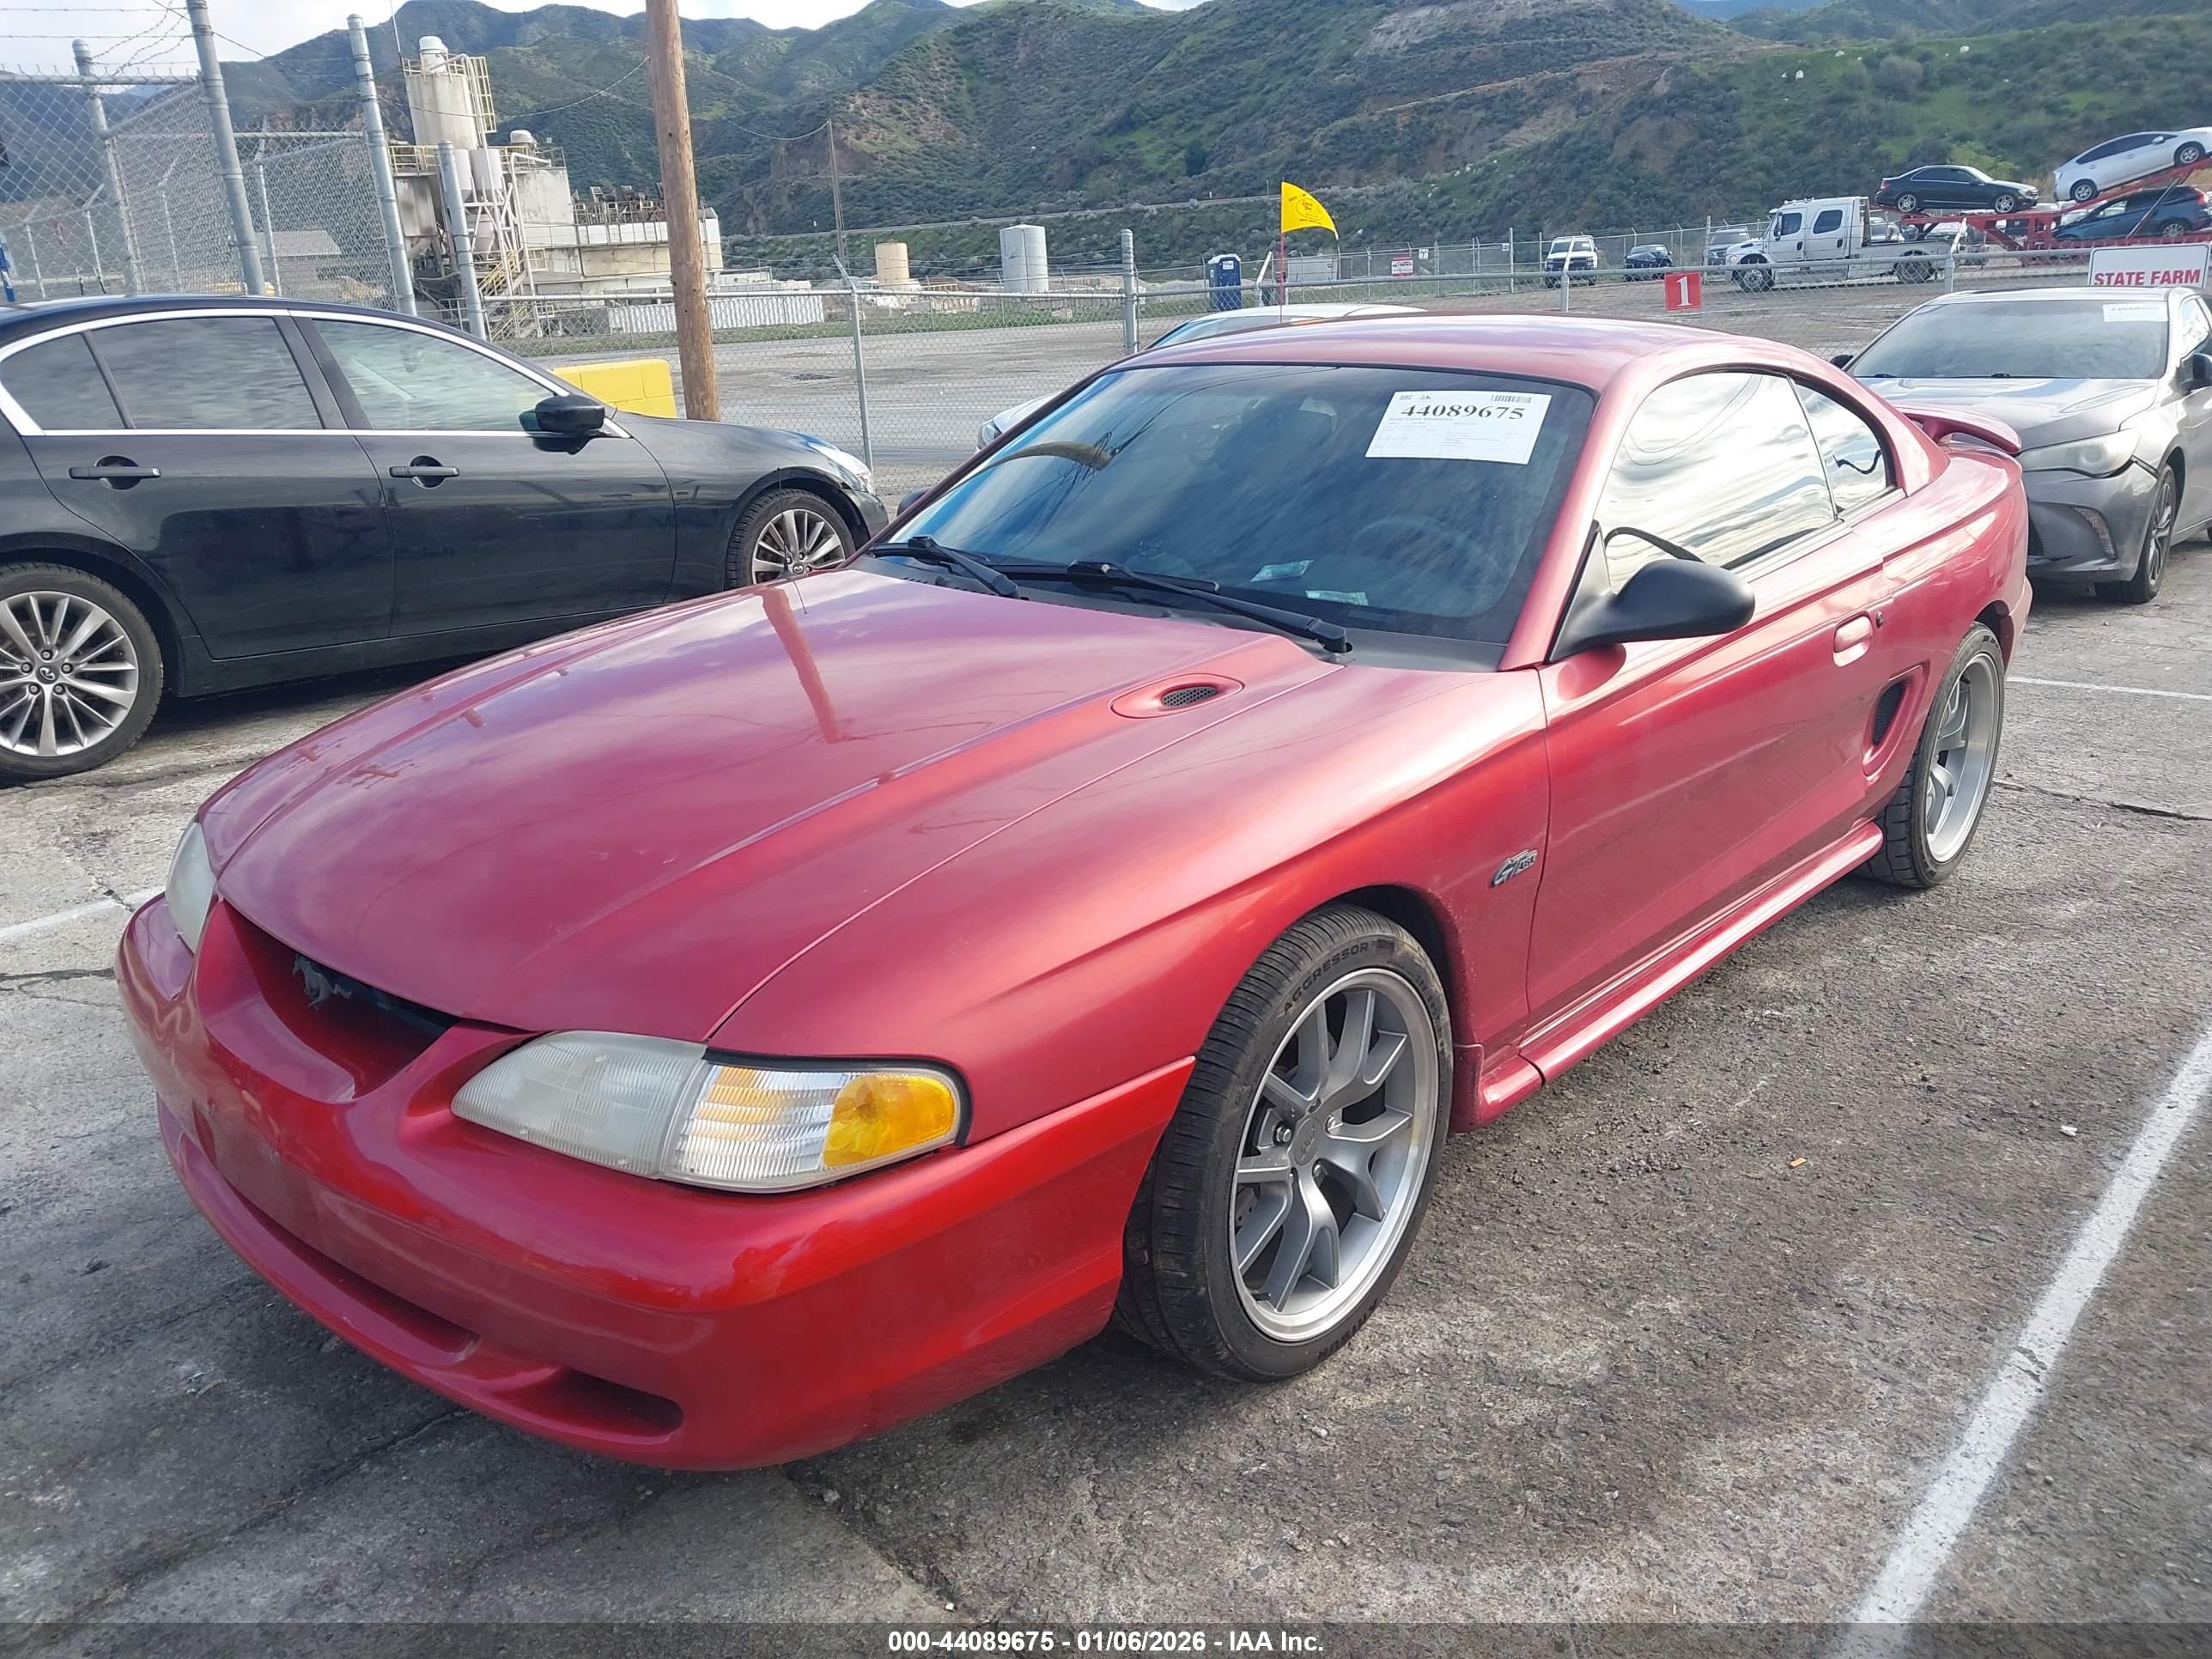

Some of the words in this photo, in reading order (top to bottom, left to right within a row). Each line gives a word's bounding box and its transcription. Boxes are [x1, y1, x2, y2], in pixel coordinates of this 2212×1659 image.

[2094, 271, 2145, 286] STATE
[2149, 269, 2201, 285] FARM
[1675, 275, 1693, 307] 1
[1401, 404, 1526, 421] 44089675
[1282, 942, 1369, 1017] AGGRESSOR
